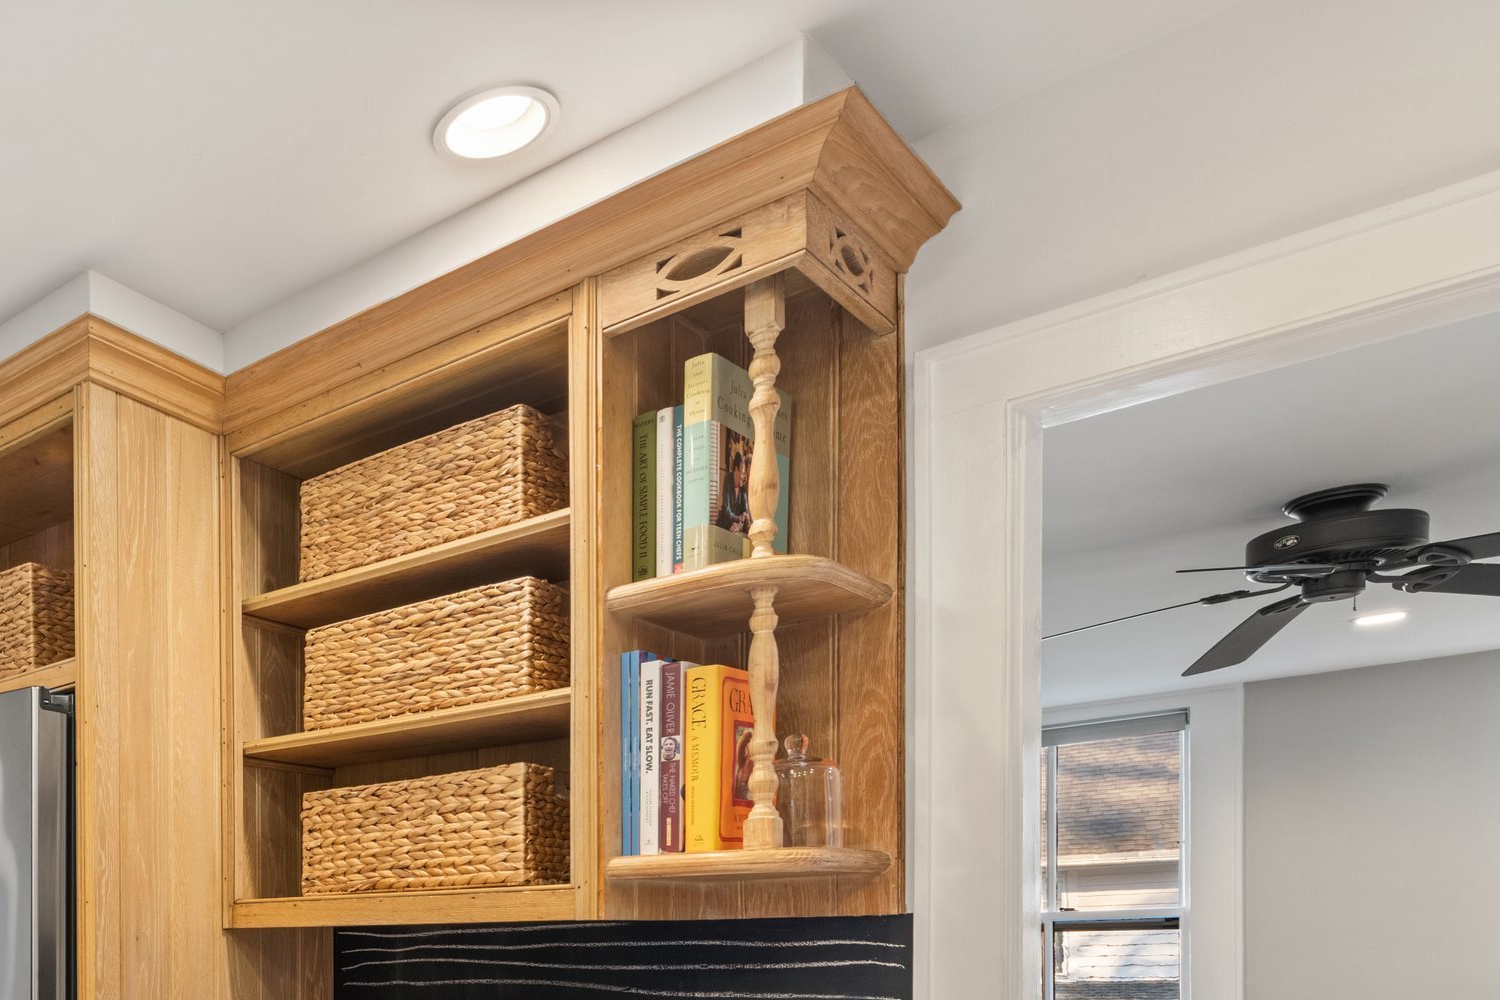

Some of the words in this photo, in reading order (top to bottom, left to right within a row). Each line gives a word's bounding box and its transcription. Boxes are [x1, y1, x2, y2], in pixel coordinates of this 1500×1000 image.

[730, 380, 747, 399] Julia
[717, 395, 751, 429] Cooking
[639, 433, 648, 449] THE
[639, 452, 648, 470] ART
[639, 472, 648, 484] OF
[639, 485, 648, 519] SIMPLE
[639, 520, 648, 550] FOOD
[645, 680, 653, 699] RUN
[665, 672, 675, 699] JAMIE
[645, 701, 653, 725] FAST.
[692, 677, 707, 731] GRACE
[729, 687, 754, 716] GRA
[666, 702, 675, 734] OLIVER
[645, 727, 653, 744] EAT
[645, 745, 653, 774] SLOW.
[691, 743, 700, 781] MEMOIR
